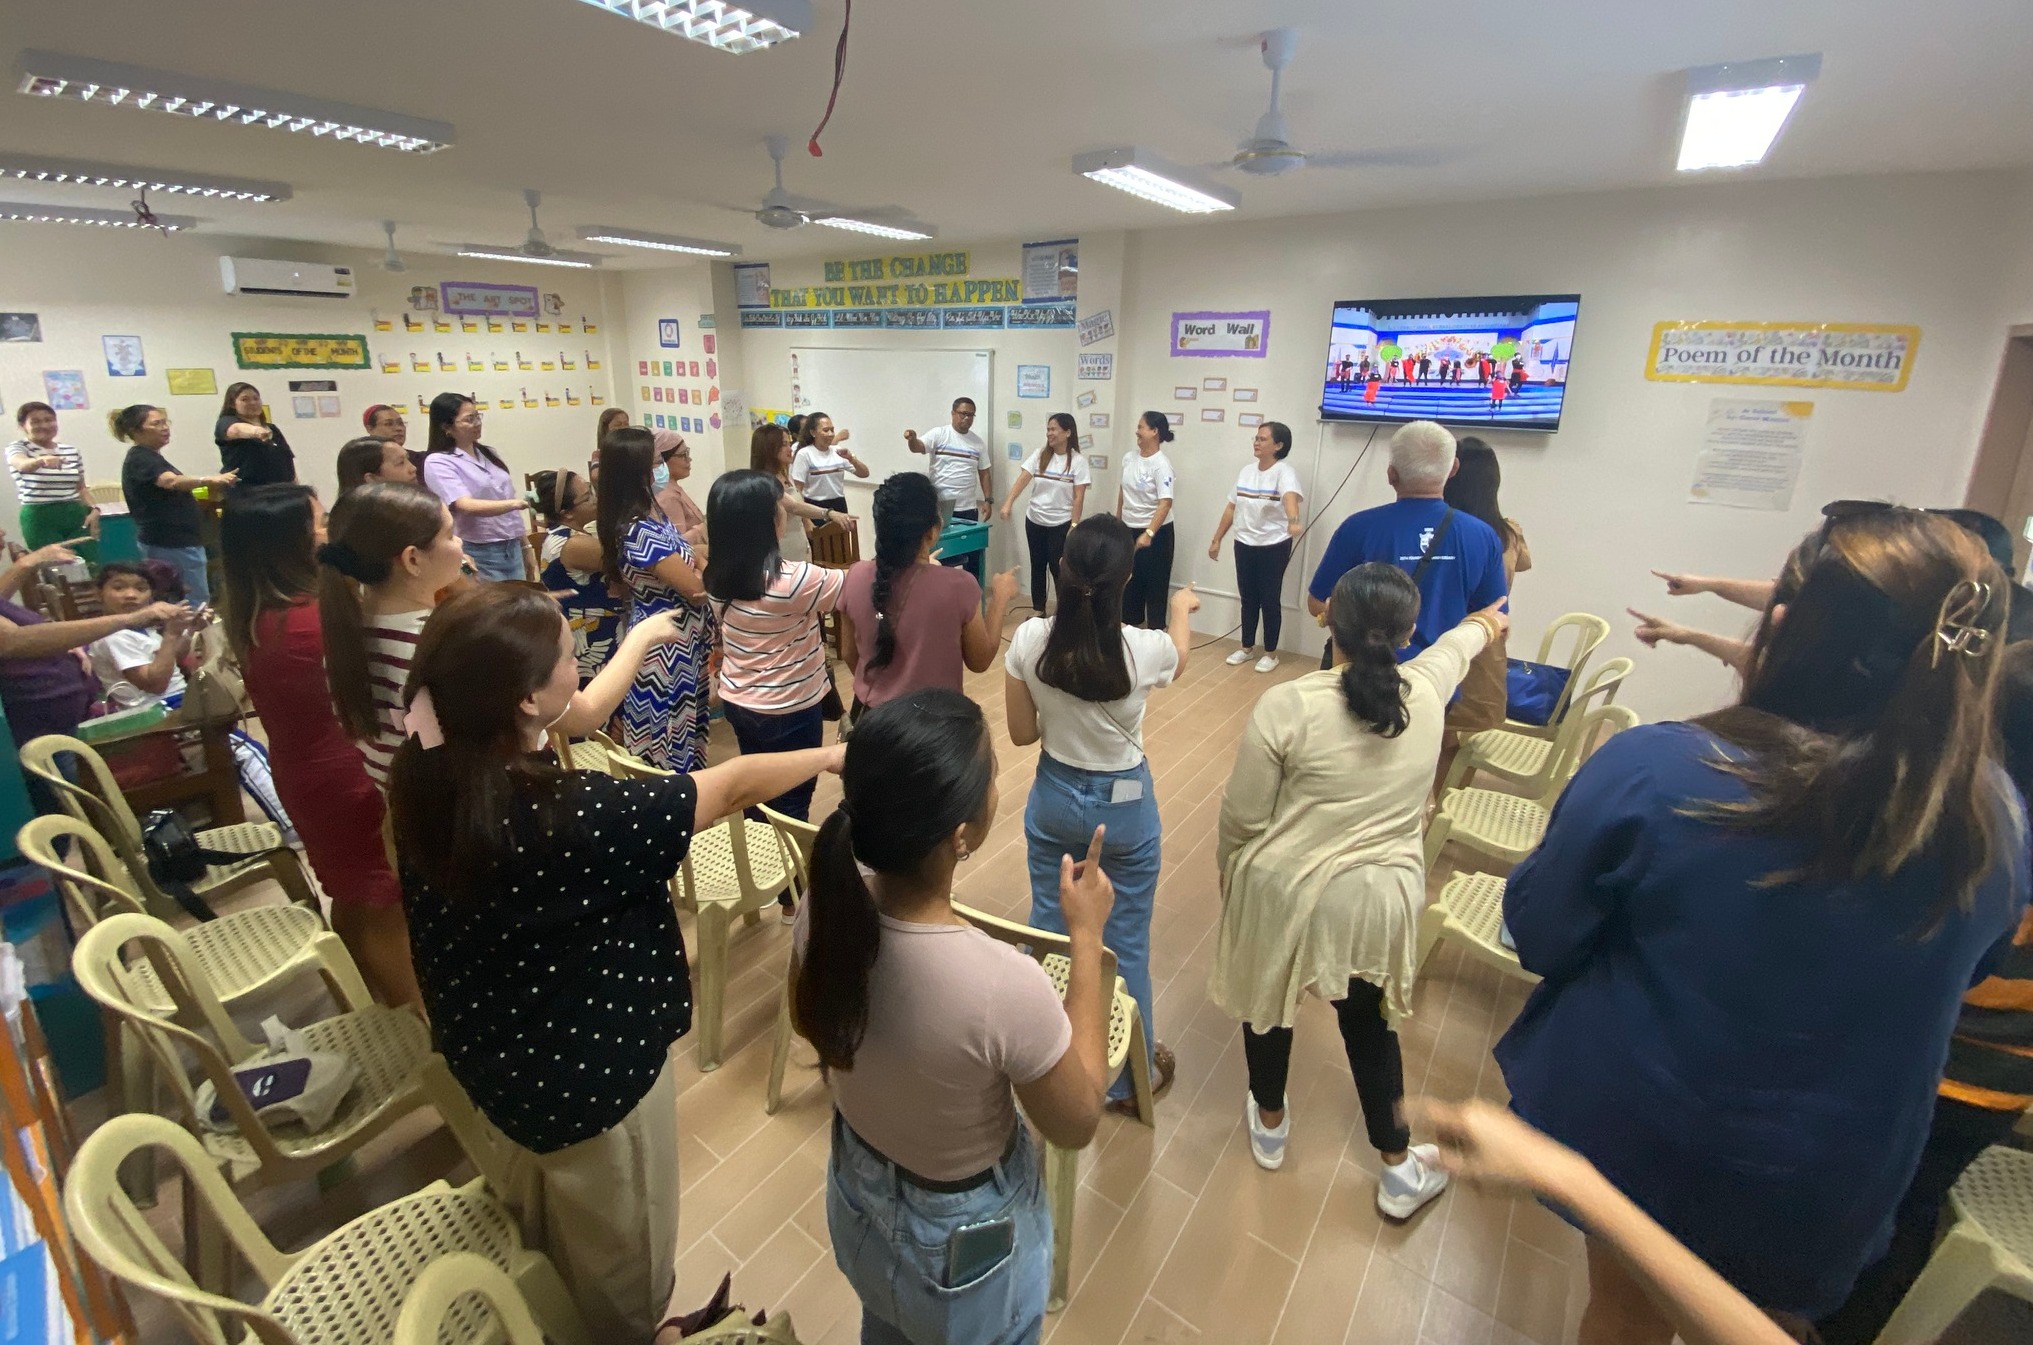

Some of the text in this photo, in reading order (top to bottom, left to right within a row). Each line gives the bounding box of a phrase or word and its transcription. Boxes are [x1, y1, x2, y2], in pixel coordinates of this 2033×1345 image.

[824, 252, 968, 282] BE THE CHANGE
[457, 292, 476, 302] THE
[771, 288, 808, 307] THAT
[814, 286, 845, 306] YOU
[848, 283, 899, 306] WANT
[933, 279, 1020, 304] HAPPEN
[1184, 322, 1255, 335] Word Wall
[1080, 354, 1110, 365] Words
[1663, 346, 1902, 370] Poem of the Month
